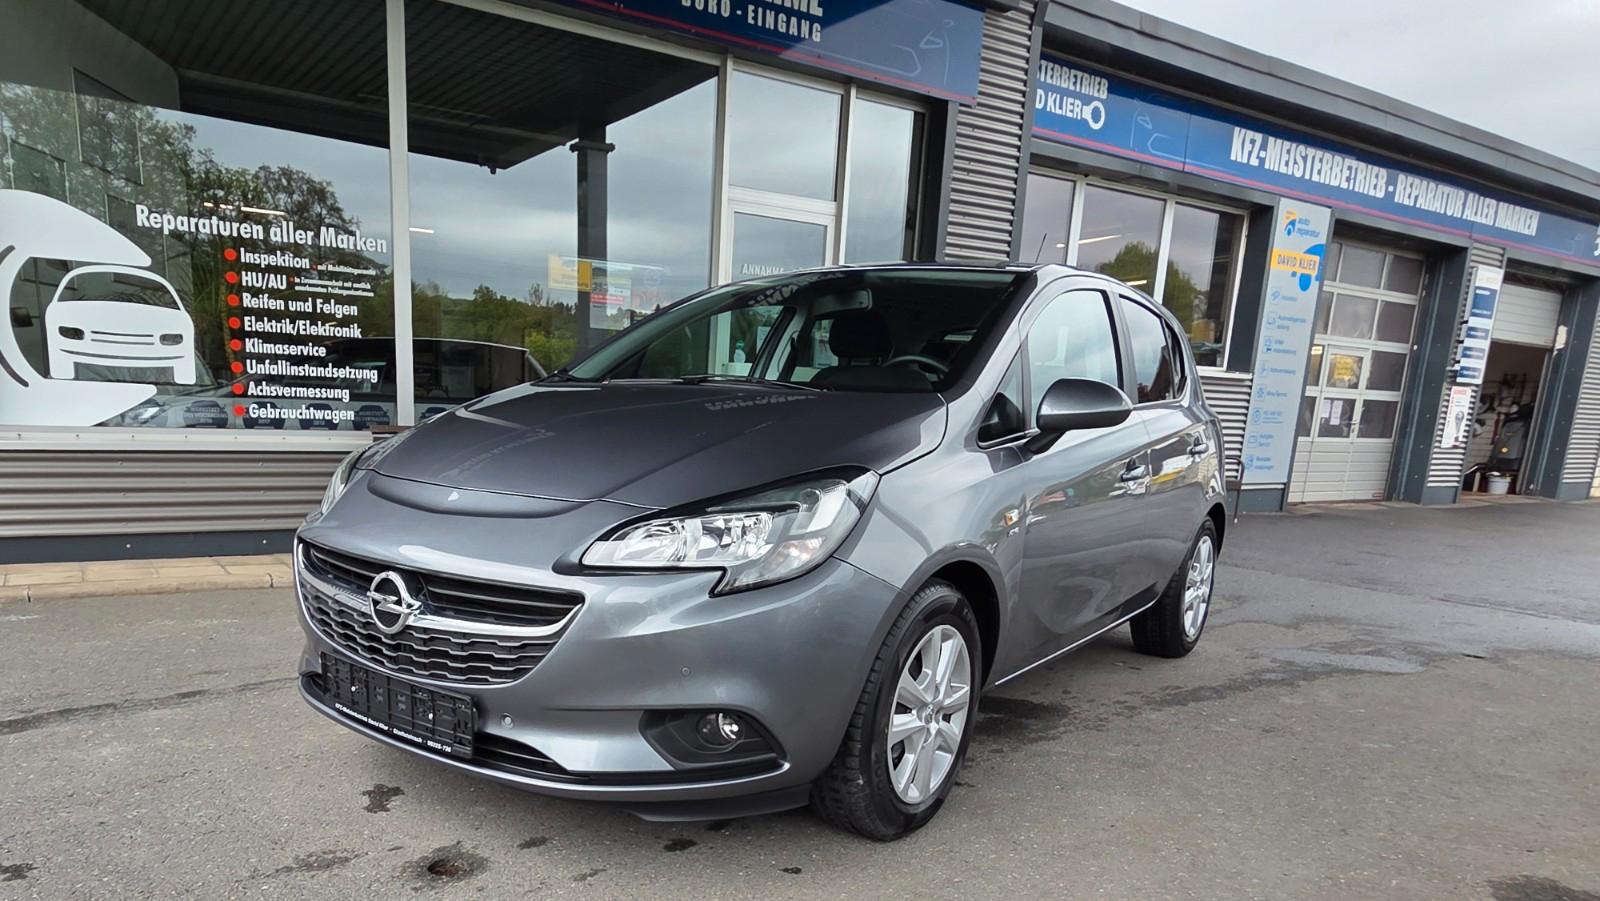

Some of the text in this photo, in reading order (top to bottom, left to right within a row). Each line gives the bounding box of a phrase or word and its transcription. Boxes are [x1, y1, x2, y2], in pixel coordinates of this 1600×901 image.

[747, 4, 821, 42] EINGANG
[1037, 59, 1109, 99] TERBETRIEB
[1046, 92, 1082, 120] KLIER
[1230, 127, 1388, 199] KFZ-MEISTERBETRIEB
[1394, 173, 1465, 217] REPARATUR
[1462, 192, 1497, 226] ALLER
[1495, 202, 1540, 237] MARKEN
[135, 204, 387, 253] Reparaturen aller Marken
[240, 248, 310, 270] Inspektion
[1277, 254, 1297, 267] DAVID
[241, 271, 287, 290] HU/AU
[242, 293, 358, 318] Reifen und Felgen
[243, 316, 362, 338] Elektrik/Elektronik
[245, 338, 327, 357] Klimaservice
[246, 359, 378, 382] Unfallinstandsetzung
[247, 381, 350, 402] Achsvermessung
[249, 404, 355, 422] Gebrauchtwagen
